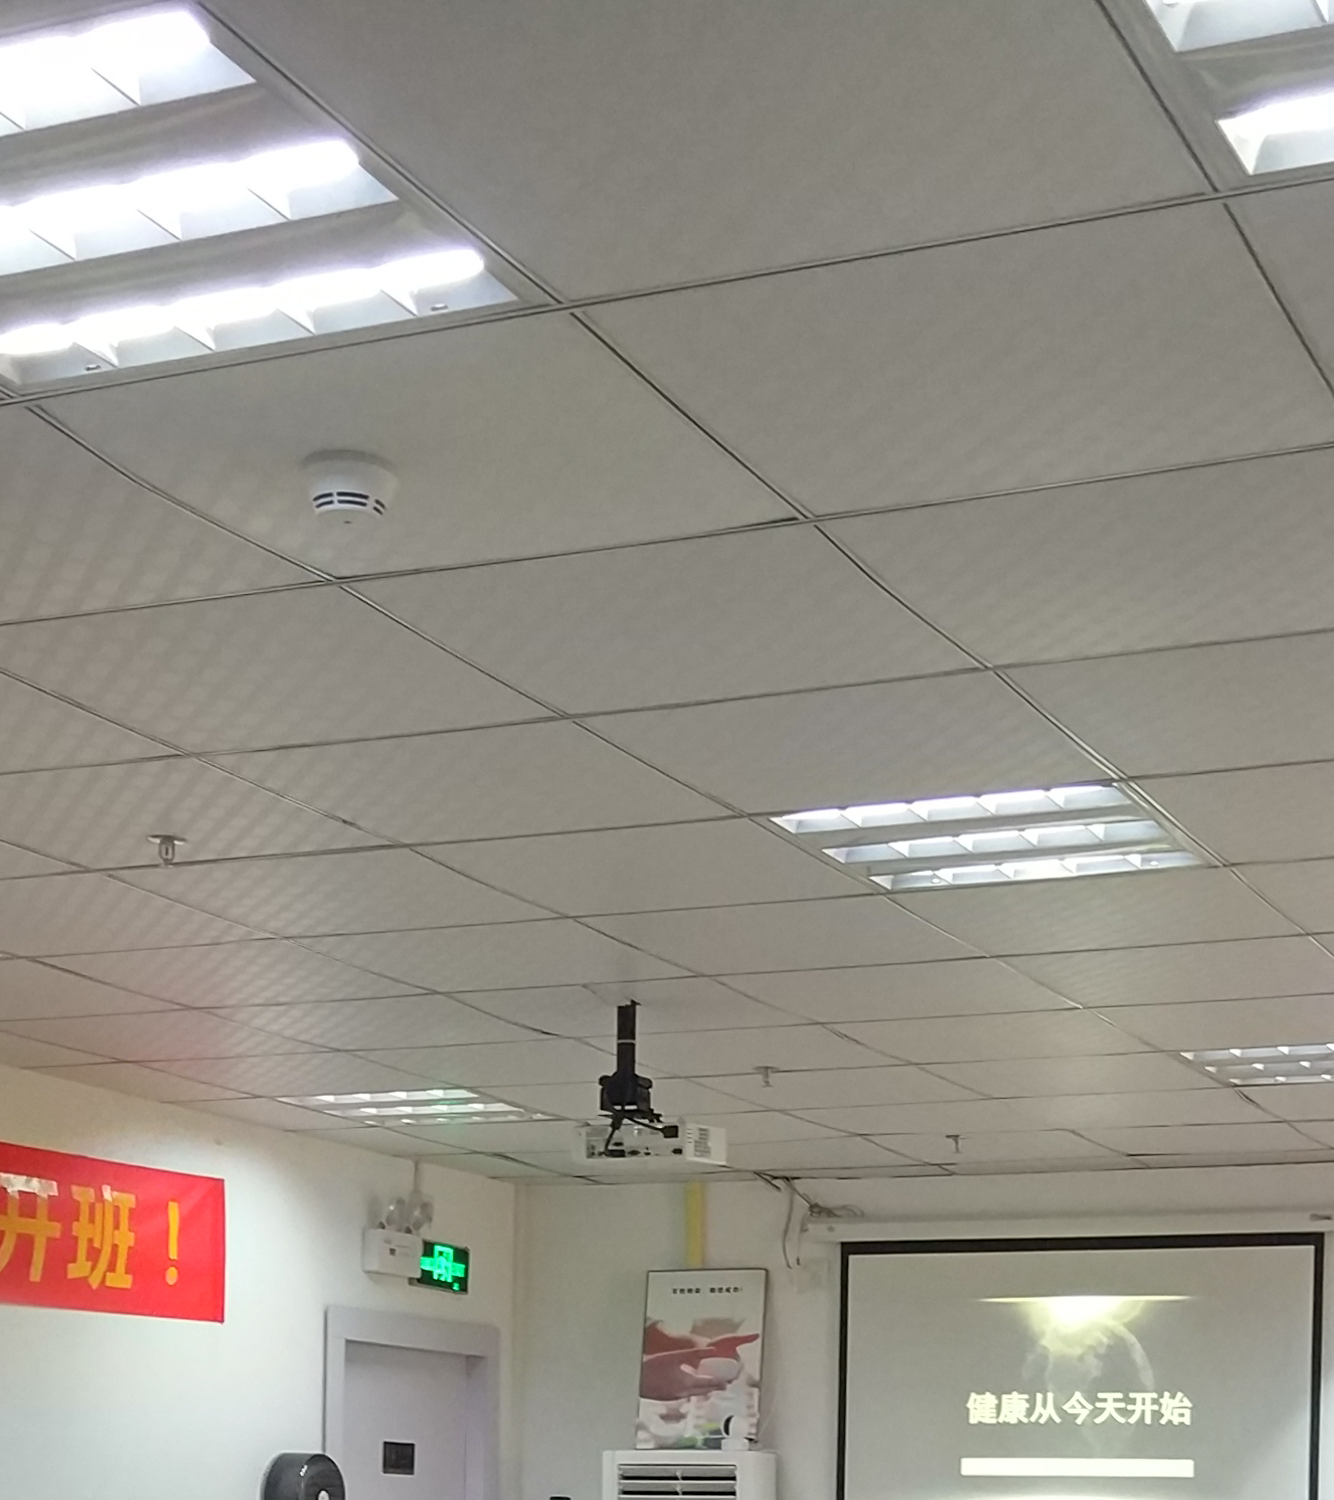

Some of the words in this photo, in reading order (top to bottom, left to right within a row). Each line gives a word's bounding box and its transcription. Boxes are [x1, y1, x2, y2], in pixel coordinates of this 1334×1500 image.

[966, 1391, 1193, 1426] 健康从今天开始
